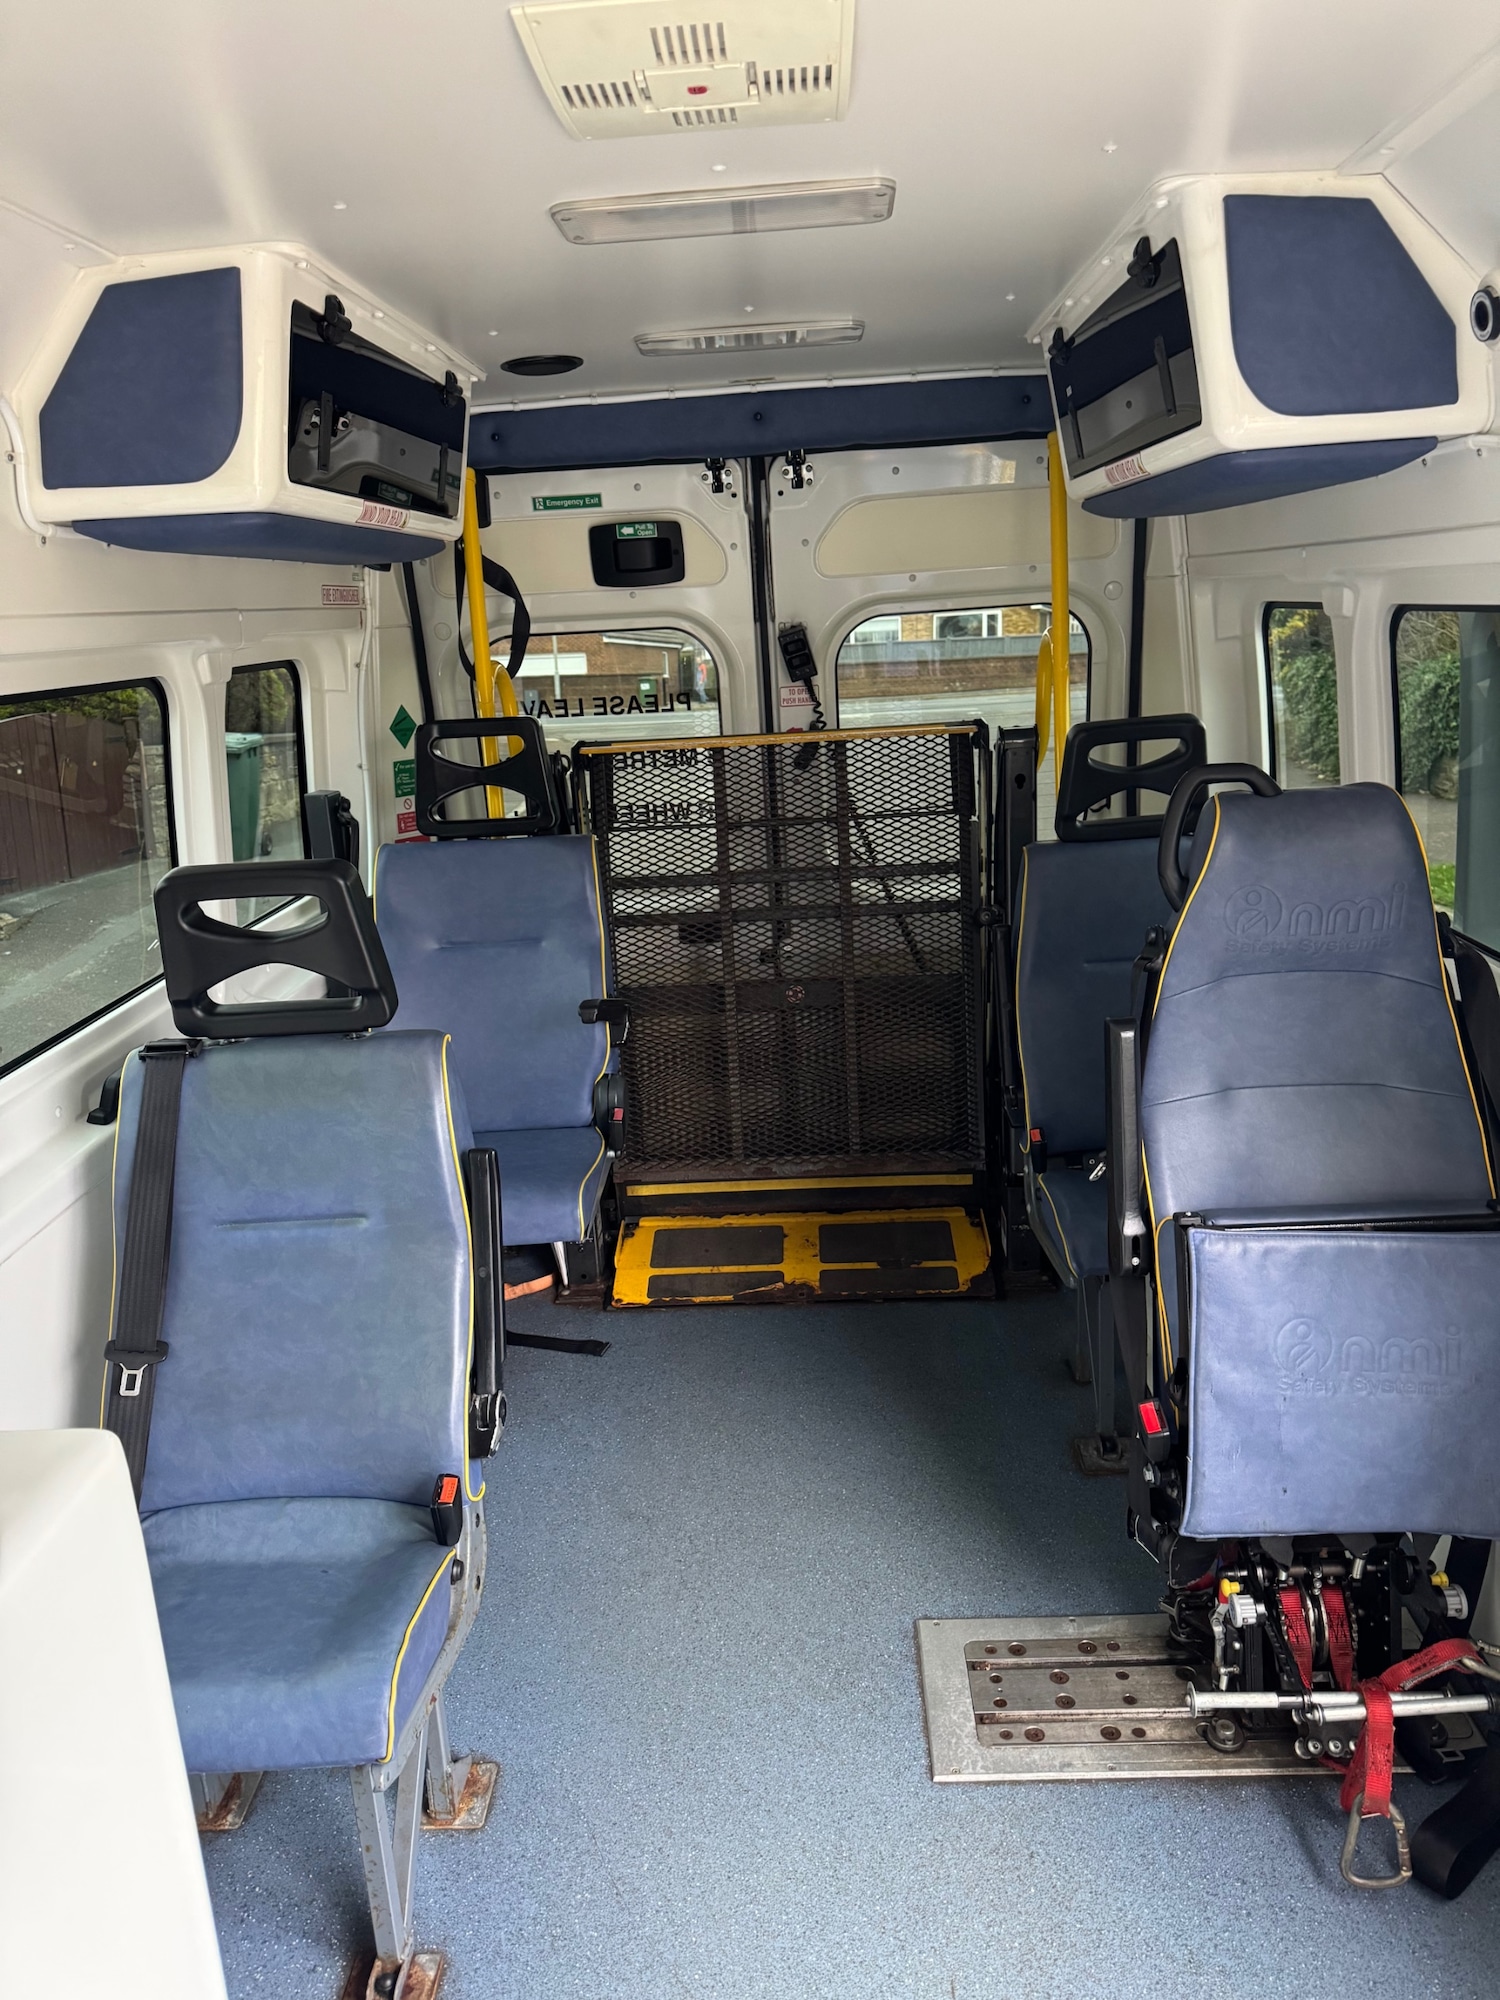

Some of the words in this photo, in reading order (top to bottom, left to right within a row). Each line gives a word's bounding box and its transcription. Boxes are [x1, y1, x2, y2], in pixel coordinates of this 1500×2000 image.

[546, 496, 584, 507] Emergency
[374, 506, 391, 524] YOUR
[387, 509, 403, 527] HEAD
[322, 587, 332, 602] FIRE
[332, 588, 359, 602] EXTINGUISHER
[788, 688, 796, 696] TO
[1288, 880, 1408, 937] nmi
[1224, 938, 1290, 955] Safety
[1297, 935, 1393, 954] Systems
[1340, 1325, 1462, 1376] nmi
[1278, 1377, 1344, 1396] Safety
[1352, 1377, 1450, 1397] Systems
